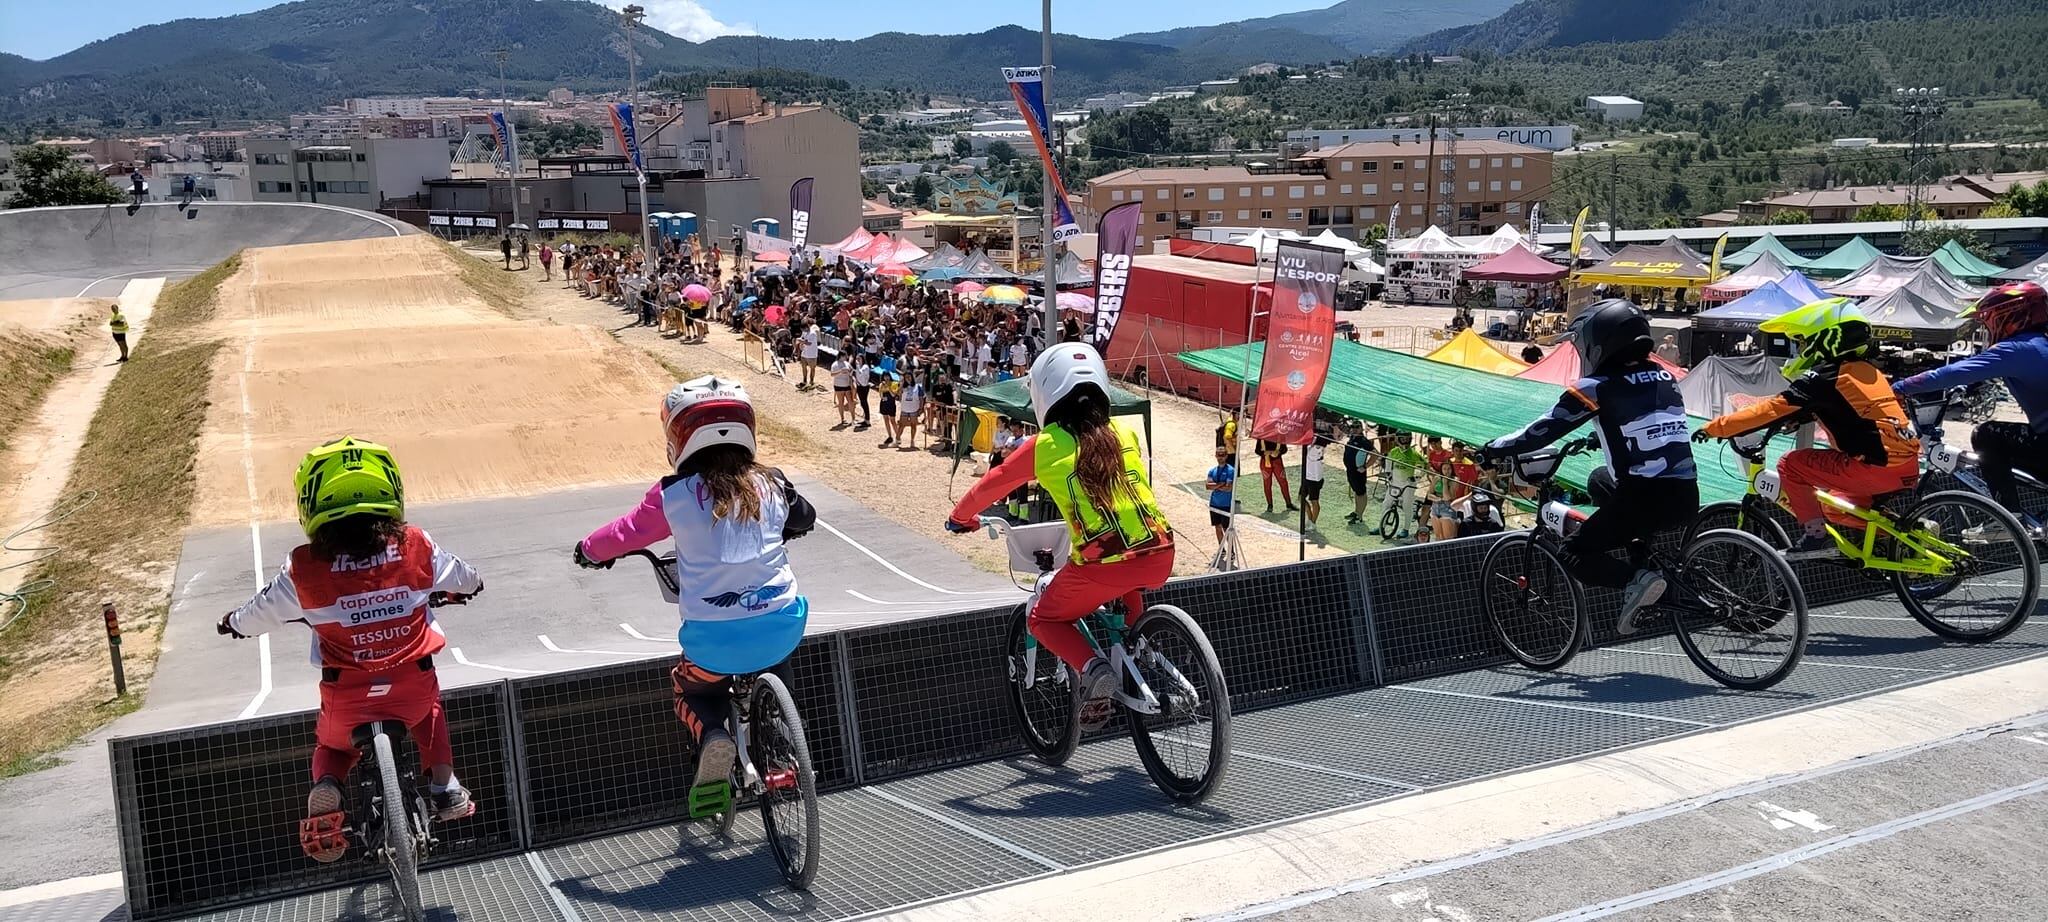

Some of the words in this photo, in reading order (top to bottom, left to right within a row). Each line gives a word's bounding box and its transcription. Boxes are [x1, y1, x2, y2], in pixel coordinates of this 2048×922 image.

[1015, 69, 1039, 77] ATIKA
[1497, 129, 1552, 144] erum
[1281, 256, 1306, 268] VIU
[1095, 253, 1130, 342] 226ERS
[1289, 348, 1309, 357] Alcoi
[1624, 370, 1673, 384] VERO
[1647, 420, 1688, 435] BMX
[341, 448, 363, 464] FLY
[1937, 451, 1950, 463] 56
[1759, 480, 1774, 493] 311
[1545, 511, 1560, 525] 182
[340, 590, 409, 610] taproom
[350, 604, 405, 624] games
[350, 625, 412, 646] TESSUTO
